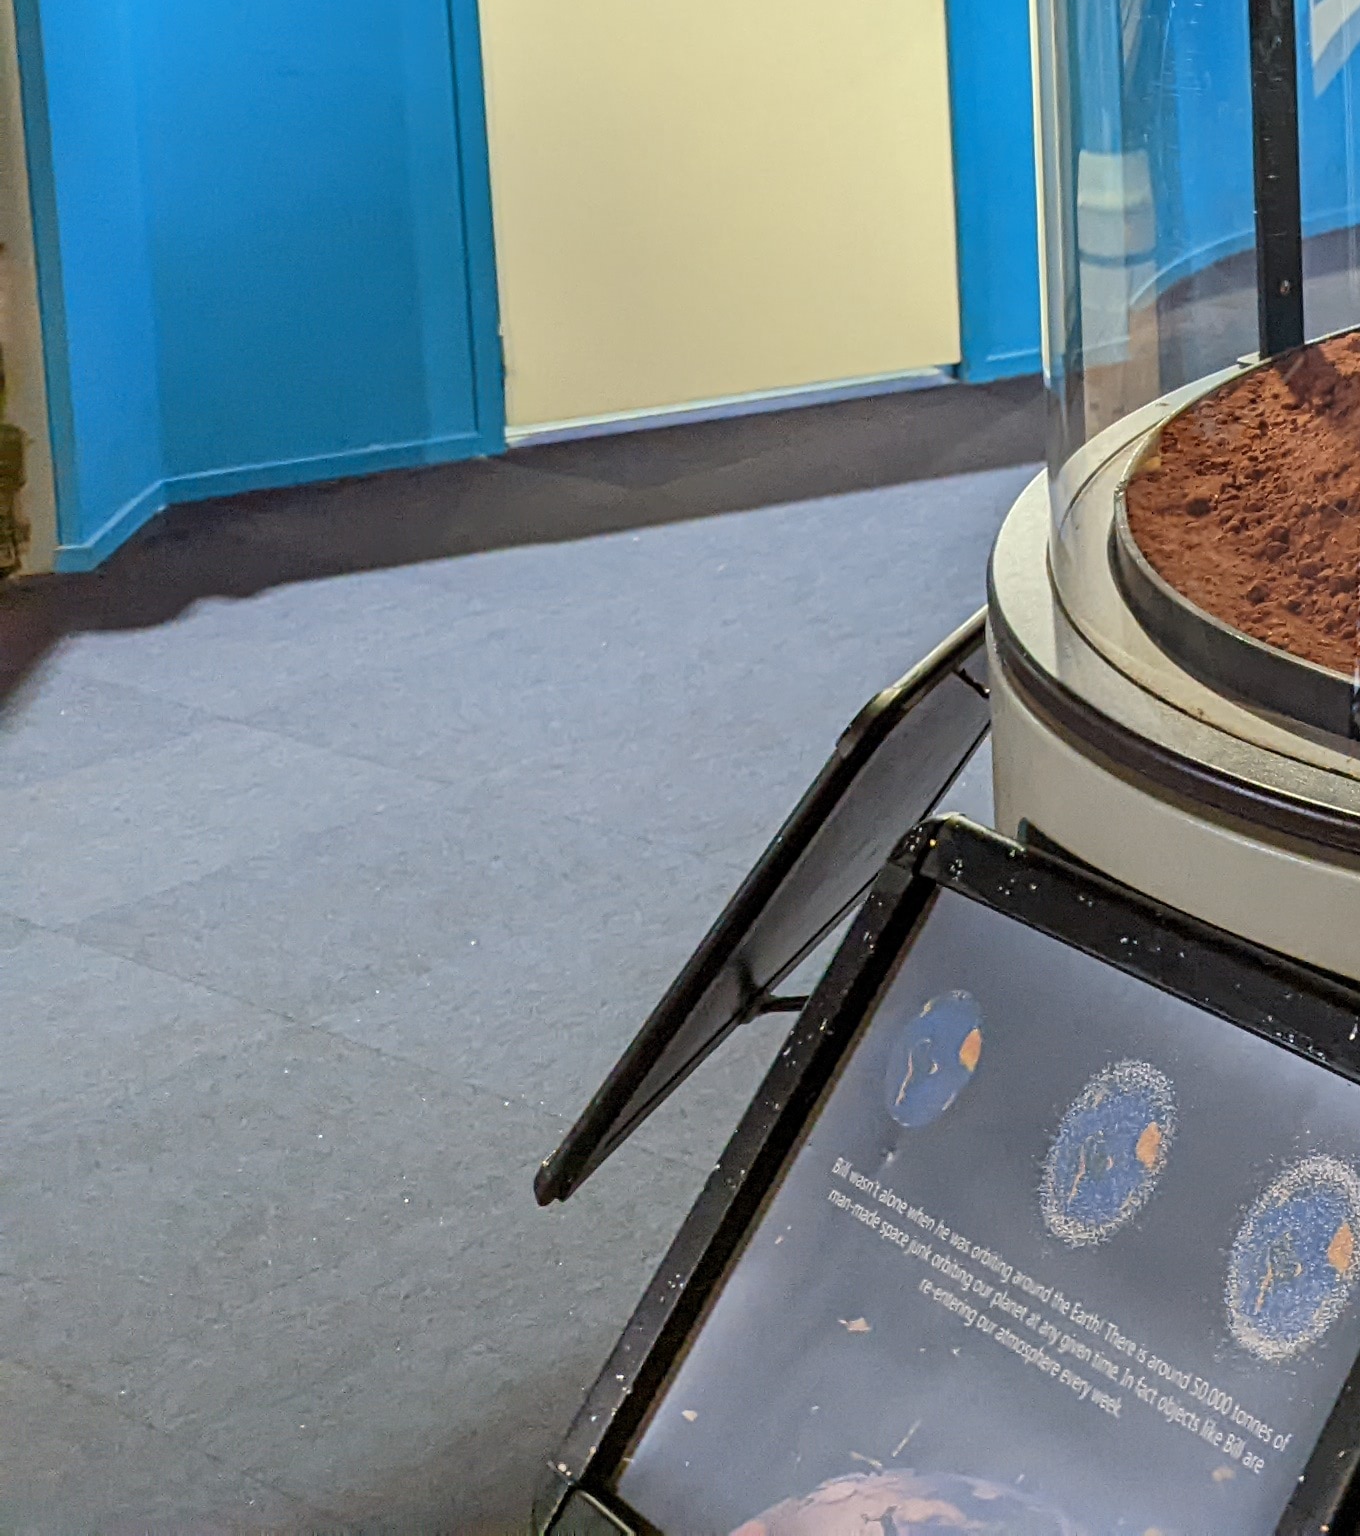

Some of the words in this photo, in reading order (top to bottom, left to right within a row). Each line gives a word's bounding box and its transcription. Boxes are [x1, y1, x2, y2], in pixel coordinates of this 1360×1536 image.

[828, 1189, 881, 1228] man-made
[879, 1221, 909, 1248] space
[904, 1239, 932, 1261] junk
[931, 1253, 974, 1292] orbiting
[972, 1277, 994, 1298] our
[990, 1289, 1028, 1321] planet
[1025, 1312, 1041, 1331] at
[1039, 1320, 1062, 1345] any
[1057, 1332, 1092, 1362] given
[1119, 1367, 1135, 1389] In
[1134, 1376, 1158, 1404] fact
[1157, 1395, 1200, 1432] objects
[1199, 1417, 1223, 1447] like
[1222, 1433, 1247, 1459] Bill
[1241, 1451, 1264, 1474] are
[832, 1157, 852, 1178] Bill
[849, 1171, 881, 1199] wasn't
[878, 1189, 908, 1214] alone
[907, 1207, 935, 1230] when
[933, 1219, 950, 1240] he
[950, 1231, 971, 1253] was
[970, 1243, 1013, 1283] orbiting
[1011, 1270, 1054, 1302] around
[1051, 1290, 1071, 1314] the
[1070, 1302, 1105, 1335] Earth!
[1104, 1322, 1137, 1356] There
[1136, 1343, 1149, 1363] is
[1147, 1354, 1192, 1390] around
[1230, 1402, 1274, 1442] tonnes
[1273, 1432, 1293, 1452] of
[918, 1278, 978, 1327] re-entering
[976, 1315, 998, 1335] our
[994, 1326, 1061, 1376] atmosphere
[1059, 1368, 1093, 1400] every
